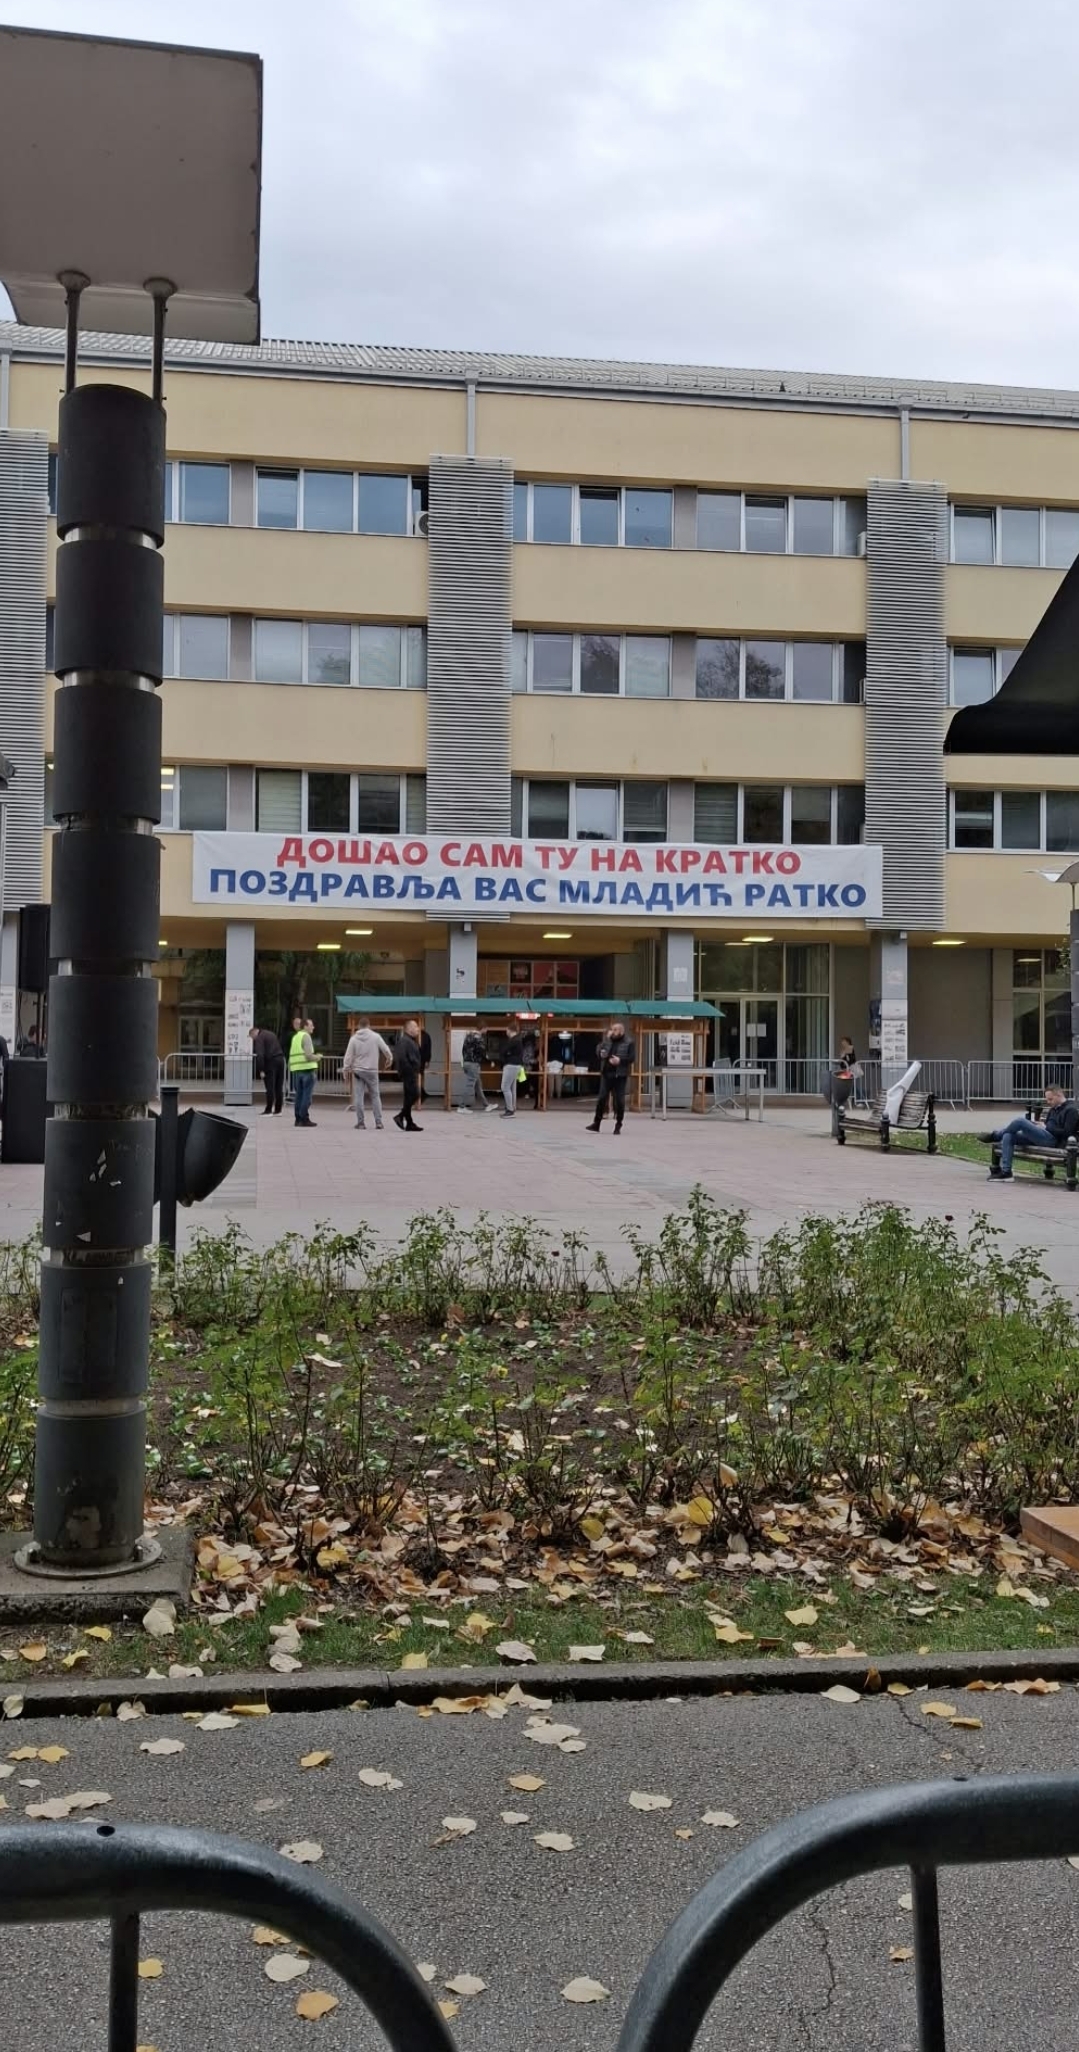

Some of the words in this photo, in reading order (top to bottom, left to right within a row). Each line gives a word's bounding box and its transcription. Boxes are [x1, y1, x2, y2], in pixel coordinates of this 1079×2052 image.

[277, 837, 429, 869] ДОШАО
[440, 842, 523, 869] САМ
[535, 846, 577, 870] ТУ
[591, 848, 643, 872] НА
[656, 850, 801, 875] КРАТКО
[210, 869, 462, 903] ПОЗДРАВЉА
[475, 878, 547, 903] ВАС
[559, 879, 732, 912] МЛАДИЋ
[745, 883, 867, 908] РАТКО
